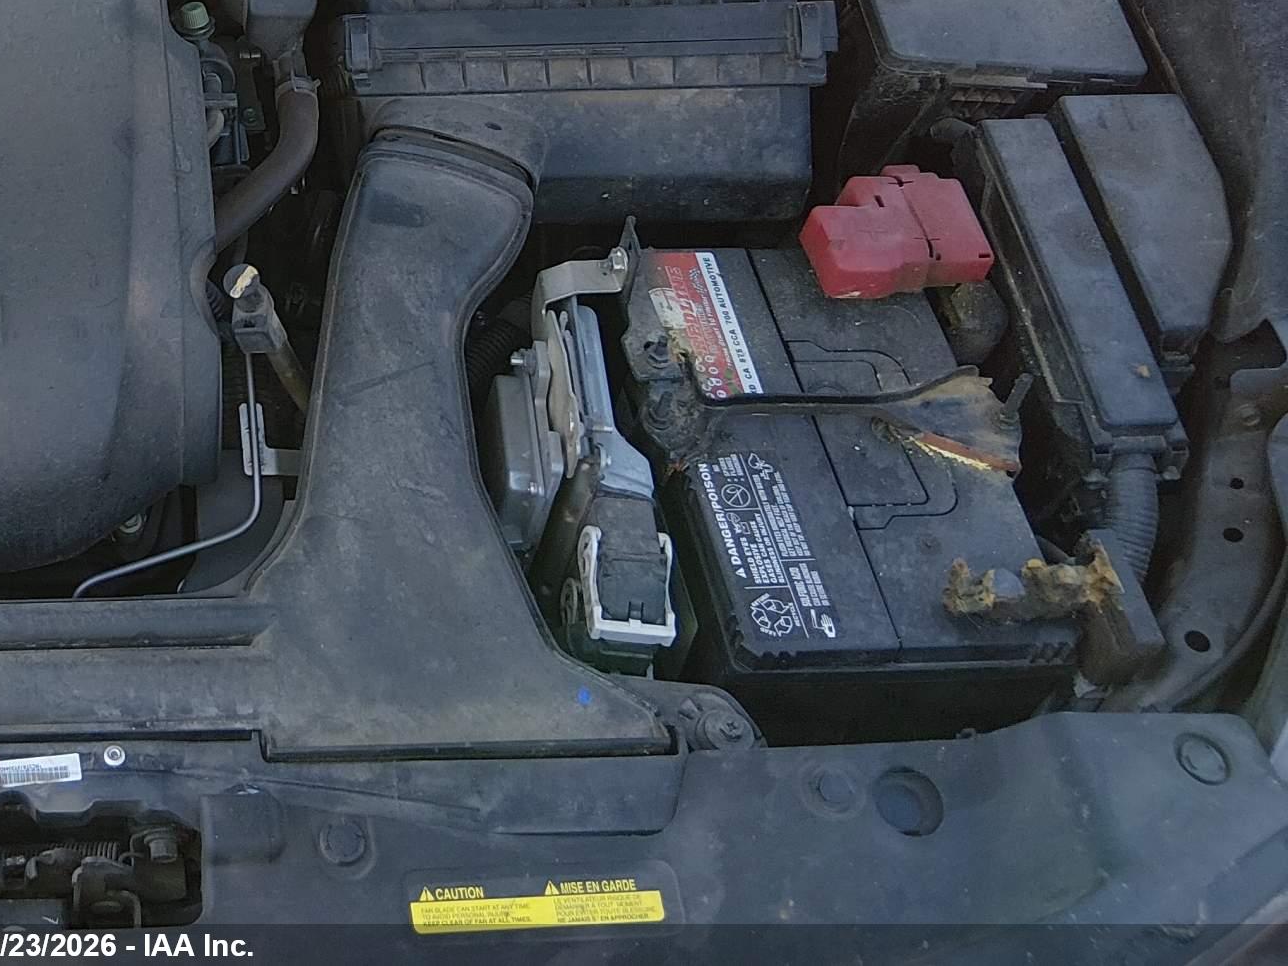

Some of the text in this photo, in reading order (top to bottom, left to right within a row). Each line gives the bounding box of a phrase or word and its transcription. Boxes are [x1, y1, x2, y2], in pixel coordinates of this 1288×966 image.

[702, 257, 728, 309] AUTOMOTIVE
[724, 310, 733, 325] 700
[729, 329, 743, 347] CCA
[744, 367, 753, 380] CA
[698, 463, 743, 565] DANGER/POISON
[740, 537, 752, 555] EYES
[749, 521, 778, 584] GASES CAN CAUSE
[754, 513, 785, 584] BLINDNESS OR INJURY
[747, 557, 762, 584] SHIELD
[749, 543, 770, 584] EXPLOSIVE
[435, 886, 485, 900] CAUTION
[560, 879, 637, 894] MISE EN GARDE
[441, 919, 464, 927] CLEAR
